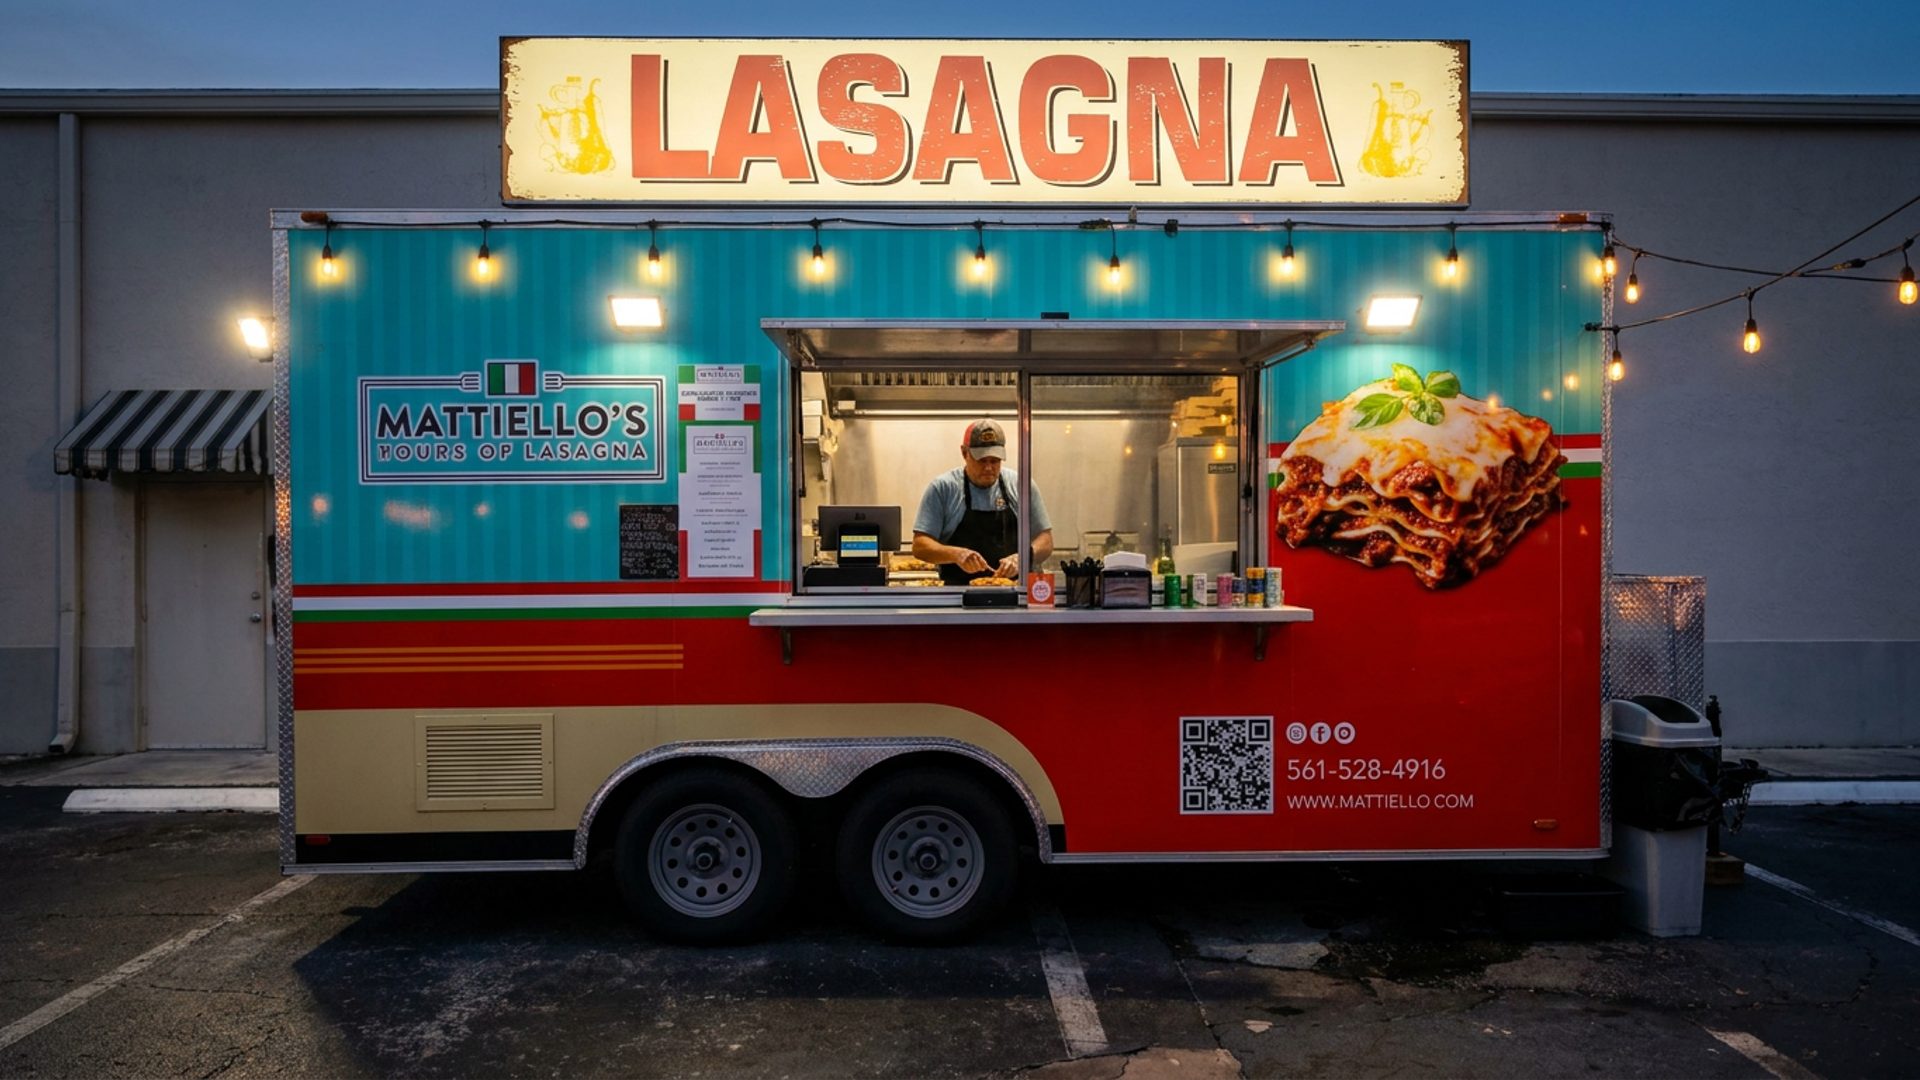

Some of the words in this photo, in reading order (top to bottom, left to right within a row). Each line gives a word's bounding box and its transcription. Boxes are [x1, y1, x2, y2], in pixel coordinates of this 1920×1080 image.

[631, 54, 1344, 187] LASAGNA
[376, 403, 648, 438] MATTIELLO'S
[524, 443, 647, 461] LASAGNA
[1287, 759, 1446, 780] 561-528-4916
